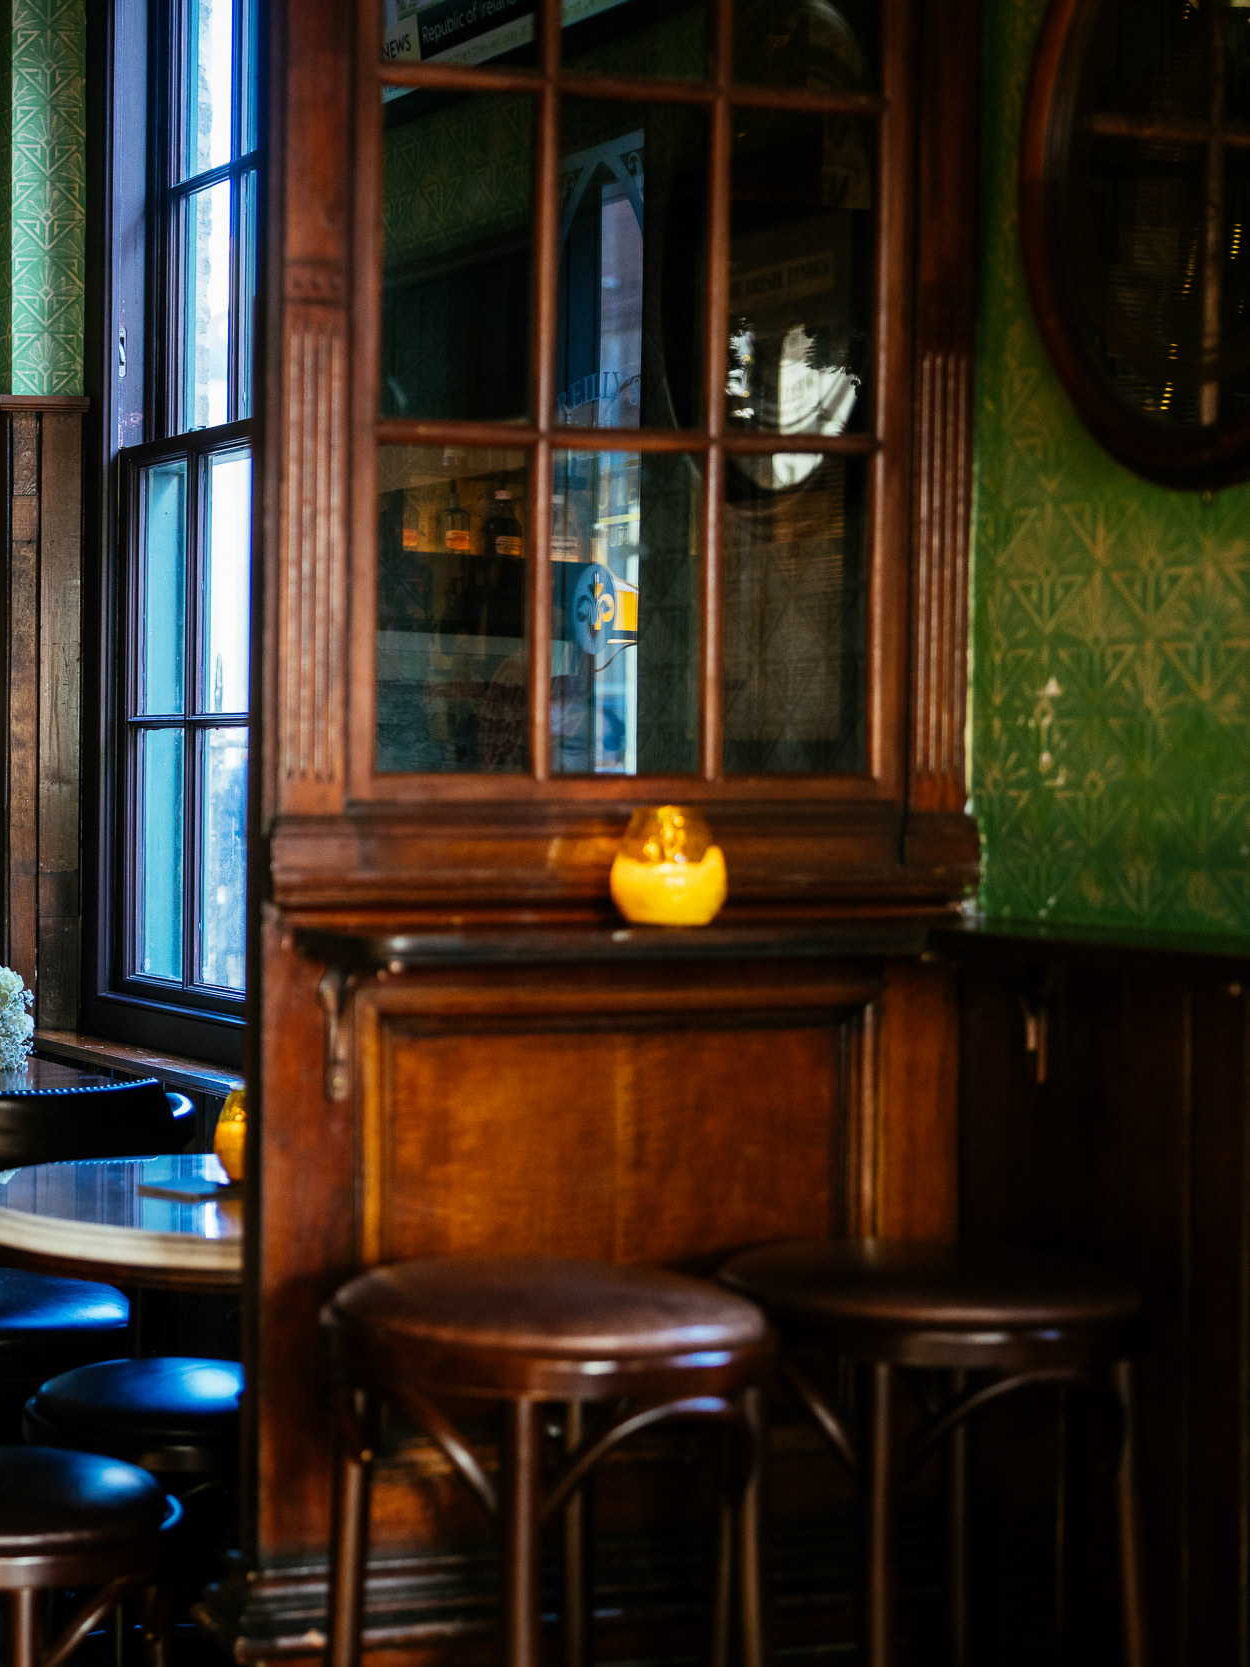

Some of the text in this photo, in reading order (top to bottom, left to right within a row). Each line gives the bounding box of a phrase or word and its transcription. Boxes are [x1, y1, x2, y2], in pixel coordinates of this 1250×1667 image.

[421, 14, 465, 44] Republic
[466, 0, 478, 24] of
[382, 33, 412, 60] NEWS
